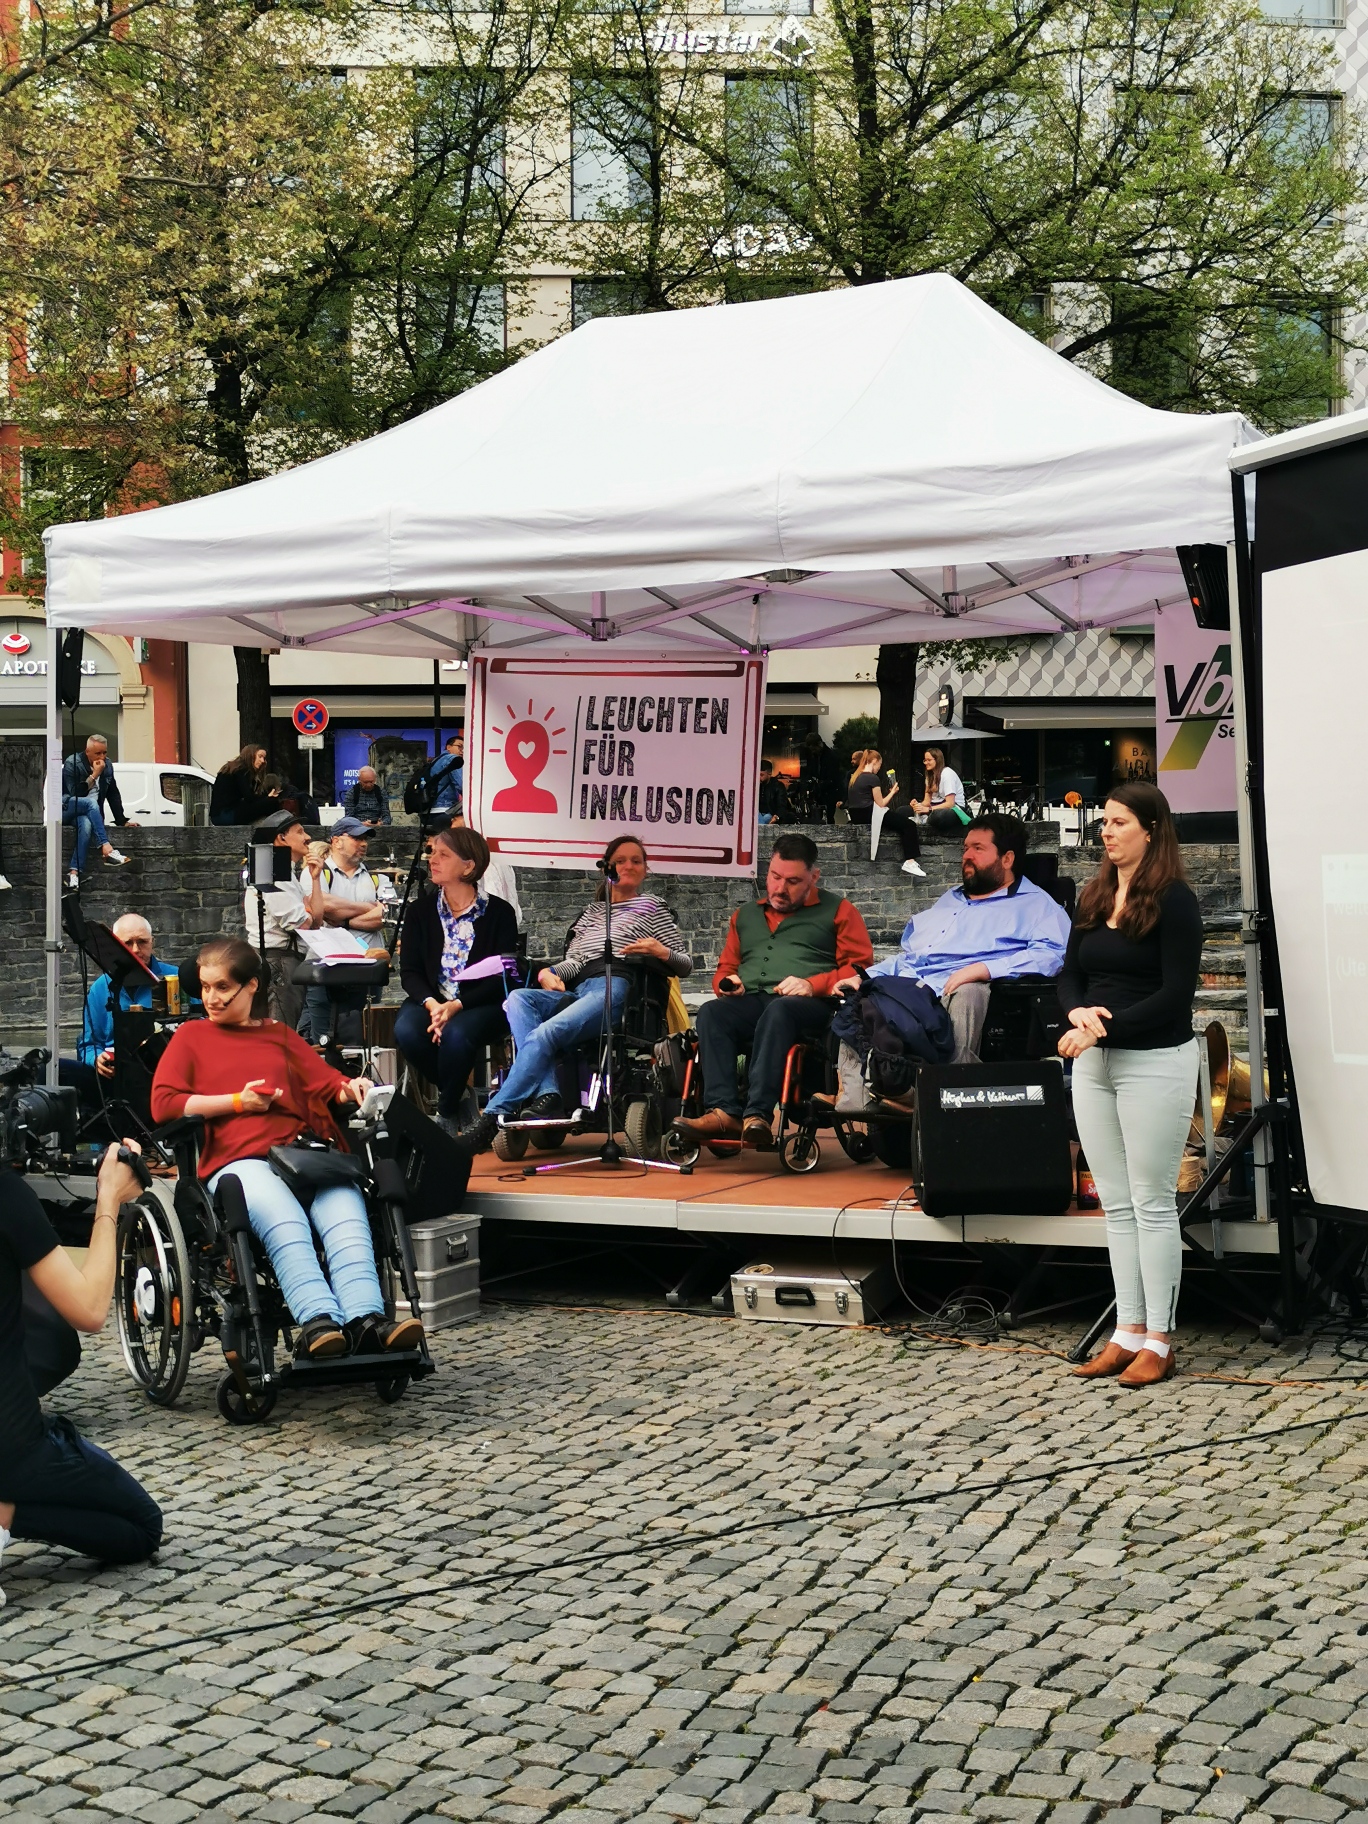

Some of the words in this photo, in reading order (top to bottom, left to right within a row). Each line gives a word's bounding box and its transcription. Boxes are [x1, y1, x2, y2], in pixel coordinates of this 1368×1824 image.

[585, 695, 730, 735] LEUCHTEN
[582, 733, 636, 777] FÜR
[579, 783, 736, 826] INKLUSION
[941, 1089, 976, 1107] Hughes
[976, 1090, 986, 1102] &
